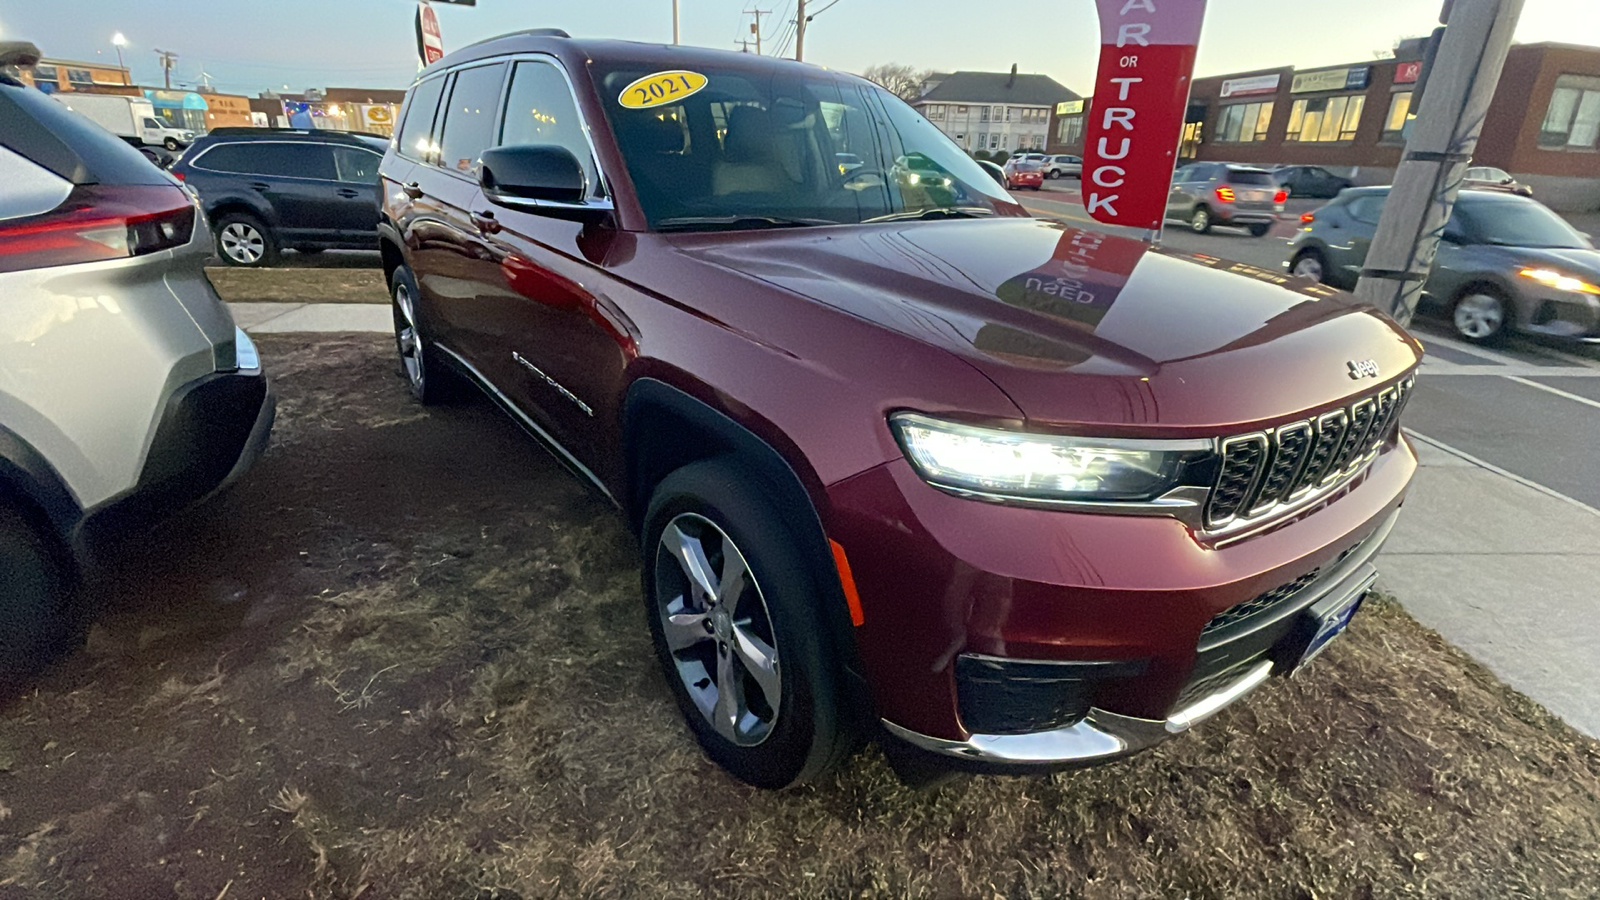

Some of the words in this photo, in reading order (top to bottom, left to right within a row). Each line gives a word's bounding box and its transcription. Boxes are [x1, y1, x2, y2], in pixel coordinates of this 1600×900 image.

[1119, 55, 1138, 68] OR
[634, 75, 691, 104] 2021
[1087, 77, 1143, 216] TRUCK
[1346, 359, 1380, 380] Jeep
